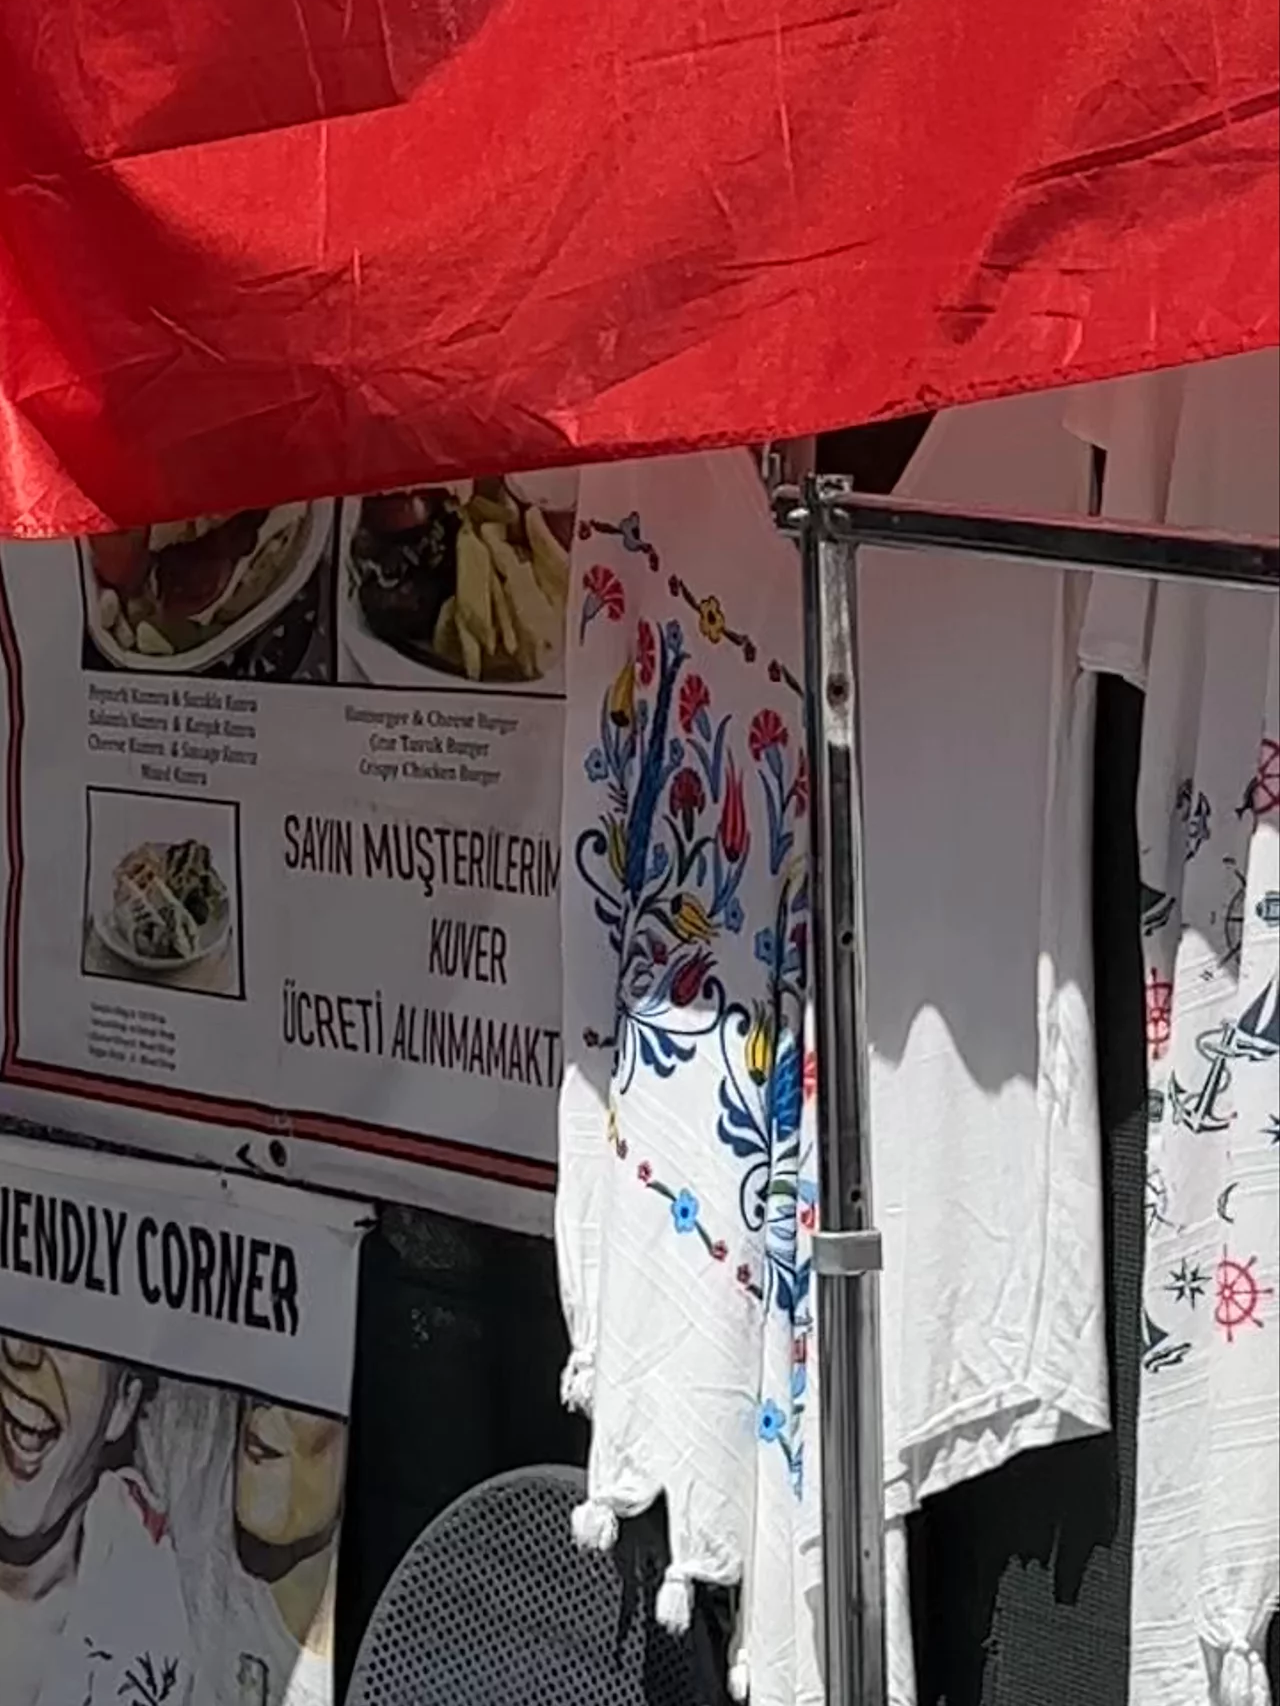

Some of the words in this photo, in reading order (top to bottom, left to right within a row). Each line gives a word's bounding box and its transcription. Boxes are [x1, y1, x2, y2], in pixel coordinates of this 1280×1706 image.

[283, 814, 353, 876] SAYIN
[282, 978, 384, 1056] ÜCRETİ
[138, 1217, 300, 1337] CORNER
